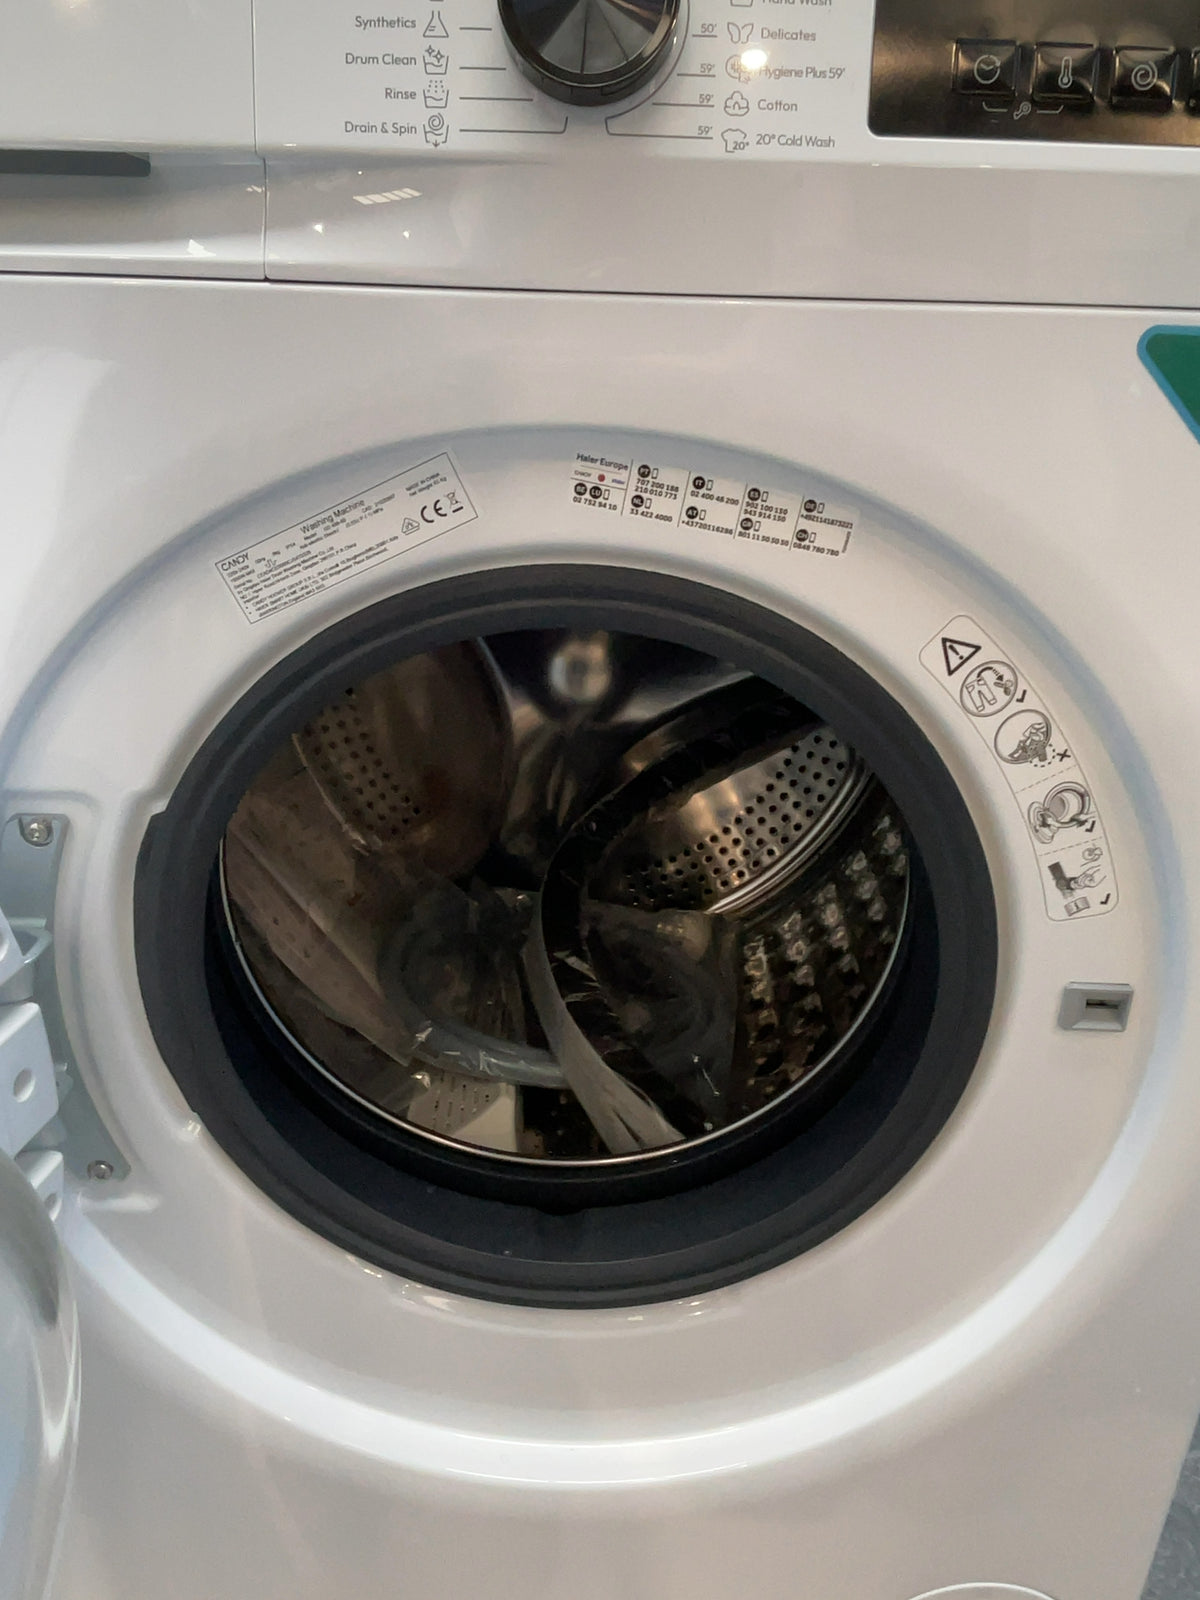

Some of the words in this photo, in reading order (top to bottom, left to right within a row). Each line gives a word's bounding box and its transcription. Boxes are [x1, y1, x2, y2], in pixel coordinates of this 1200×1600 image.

[355, 15, 417, 31] Synthetics
[760, 27, 817, 42] Delicates
[345, 52, 379, 65] Drum
[382, 53, 417, 66] Clean
[758, 65, 803, 80] Hygiene
[805, 66, 827, 79] Plus
[384, 87, 417, 100] Rinse
[757, 98, 798, 112] Cotton
[344, 121, 378, 133] Drain
[380, 122, 389, 134] &
[391, 122, 417, 136] Spin
[777, 134, 802, 147] Cold
[804, 135, 835, 148] Wash
[576, 452, 599, 464] Haier
[599, 457, 629, 472] Europe
[701, 493, 714, 501] 400
[608, 502, 618, 511] 10
[300, 513, 334, 535] Washing
[333, 500, 365, 519] Machine
[220, 552, 250, 572] CANDY
